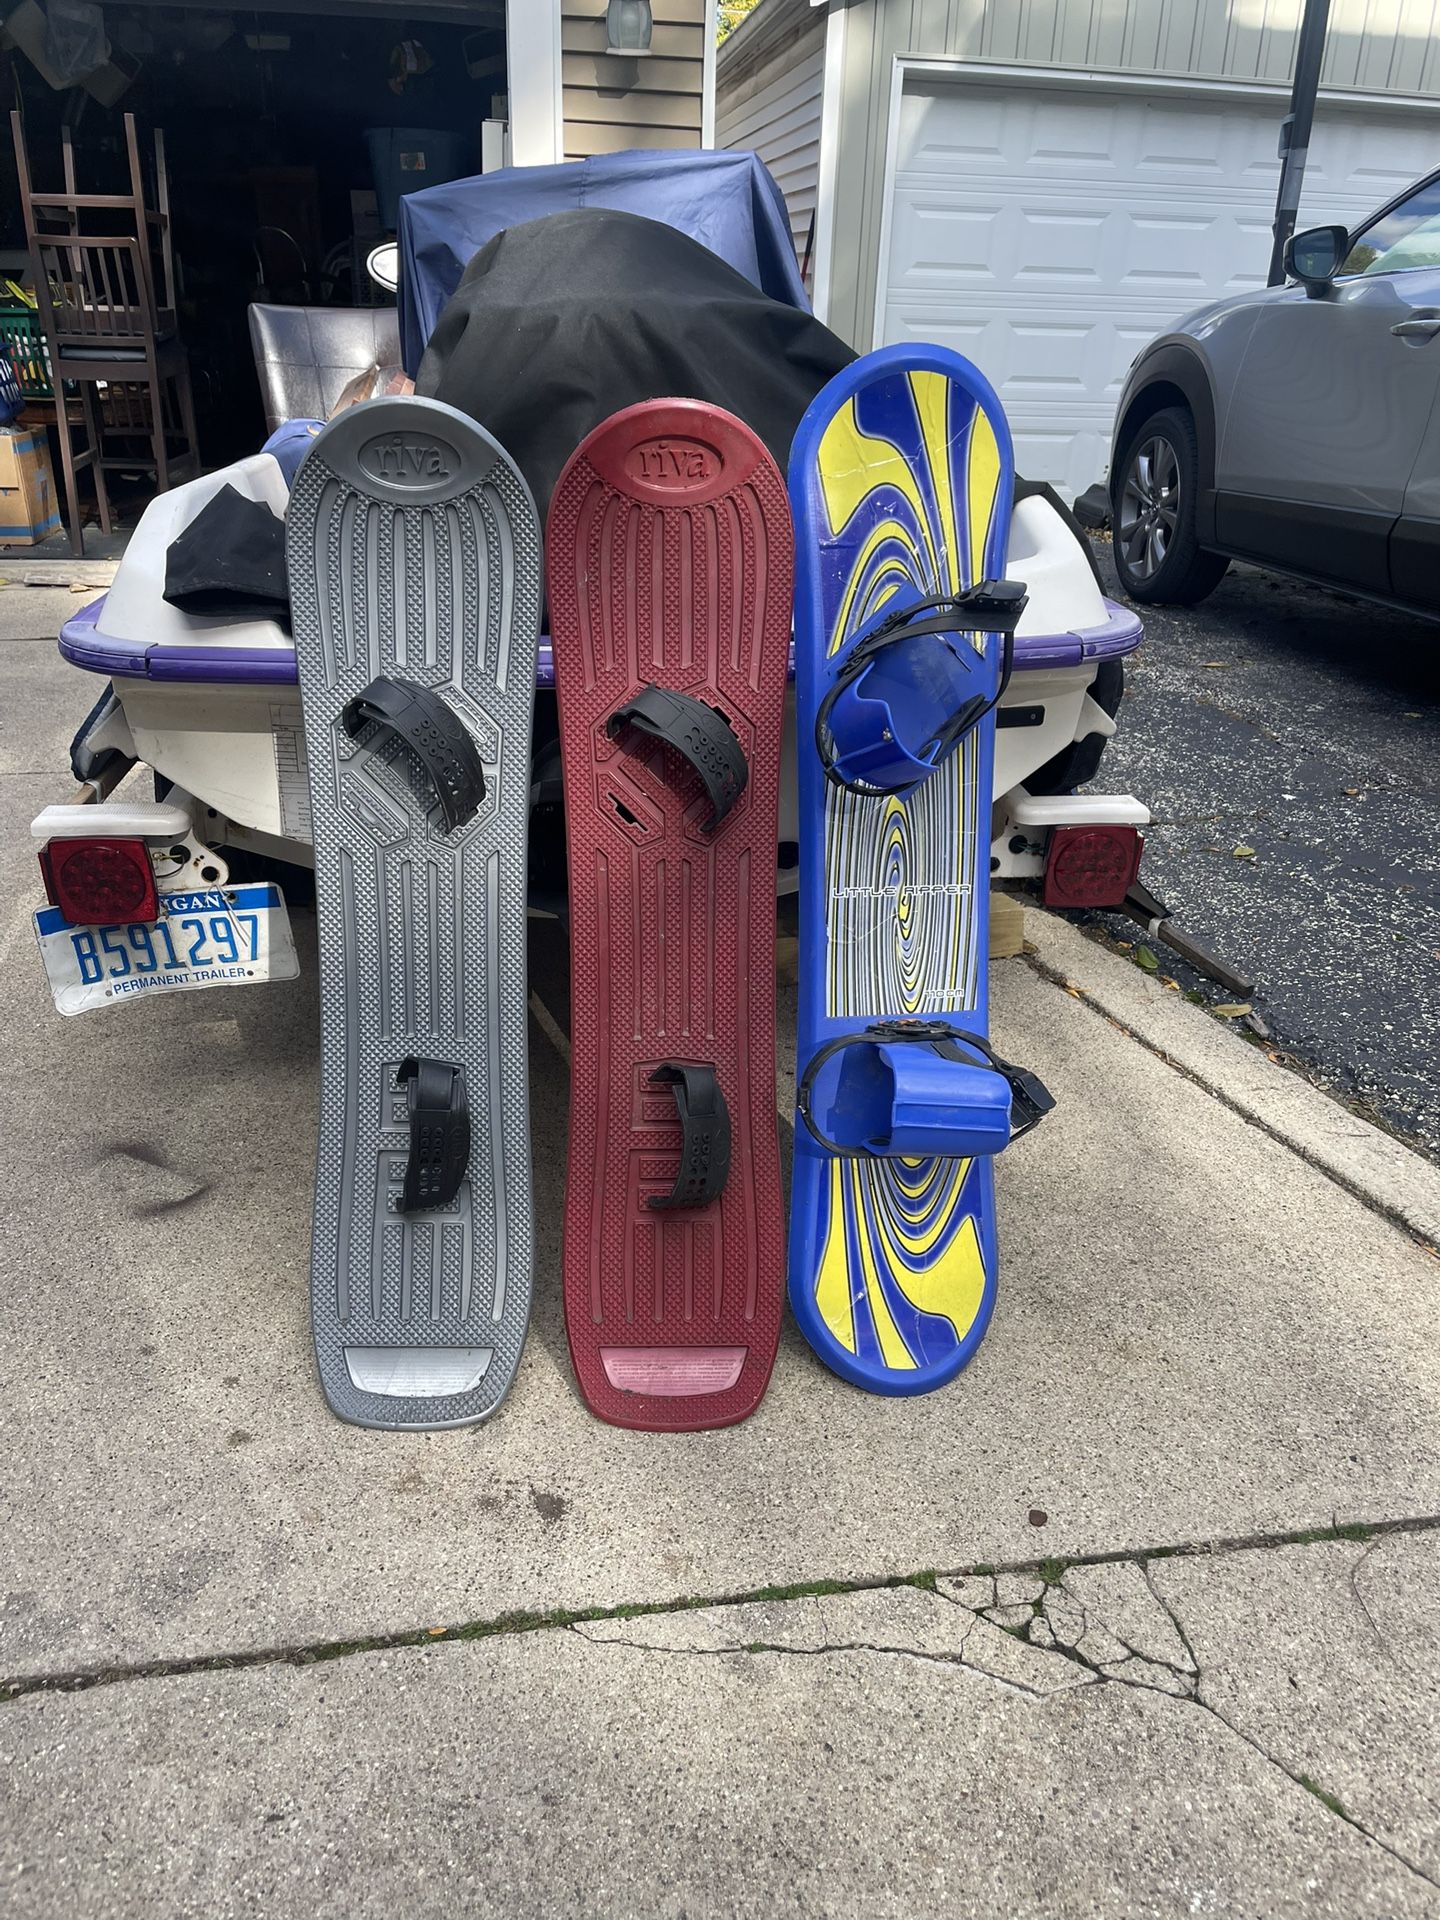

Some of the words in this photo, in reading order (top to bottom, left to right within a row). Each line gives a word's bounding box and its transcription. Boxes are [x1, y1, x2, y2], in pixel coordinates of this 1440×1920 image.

[374, 438, 450, 476] riva
[639, 441, 710, 478] riva
[833, 886, 897, 898] LITTLE
[903, 884, 971, 896] RIPPER
[70, 914, 258, 985] B591297
[113, 973, 190, 995] PERMANENT
[192, 968, 247, 982] TRAILER
